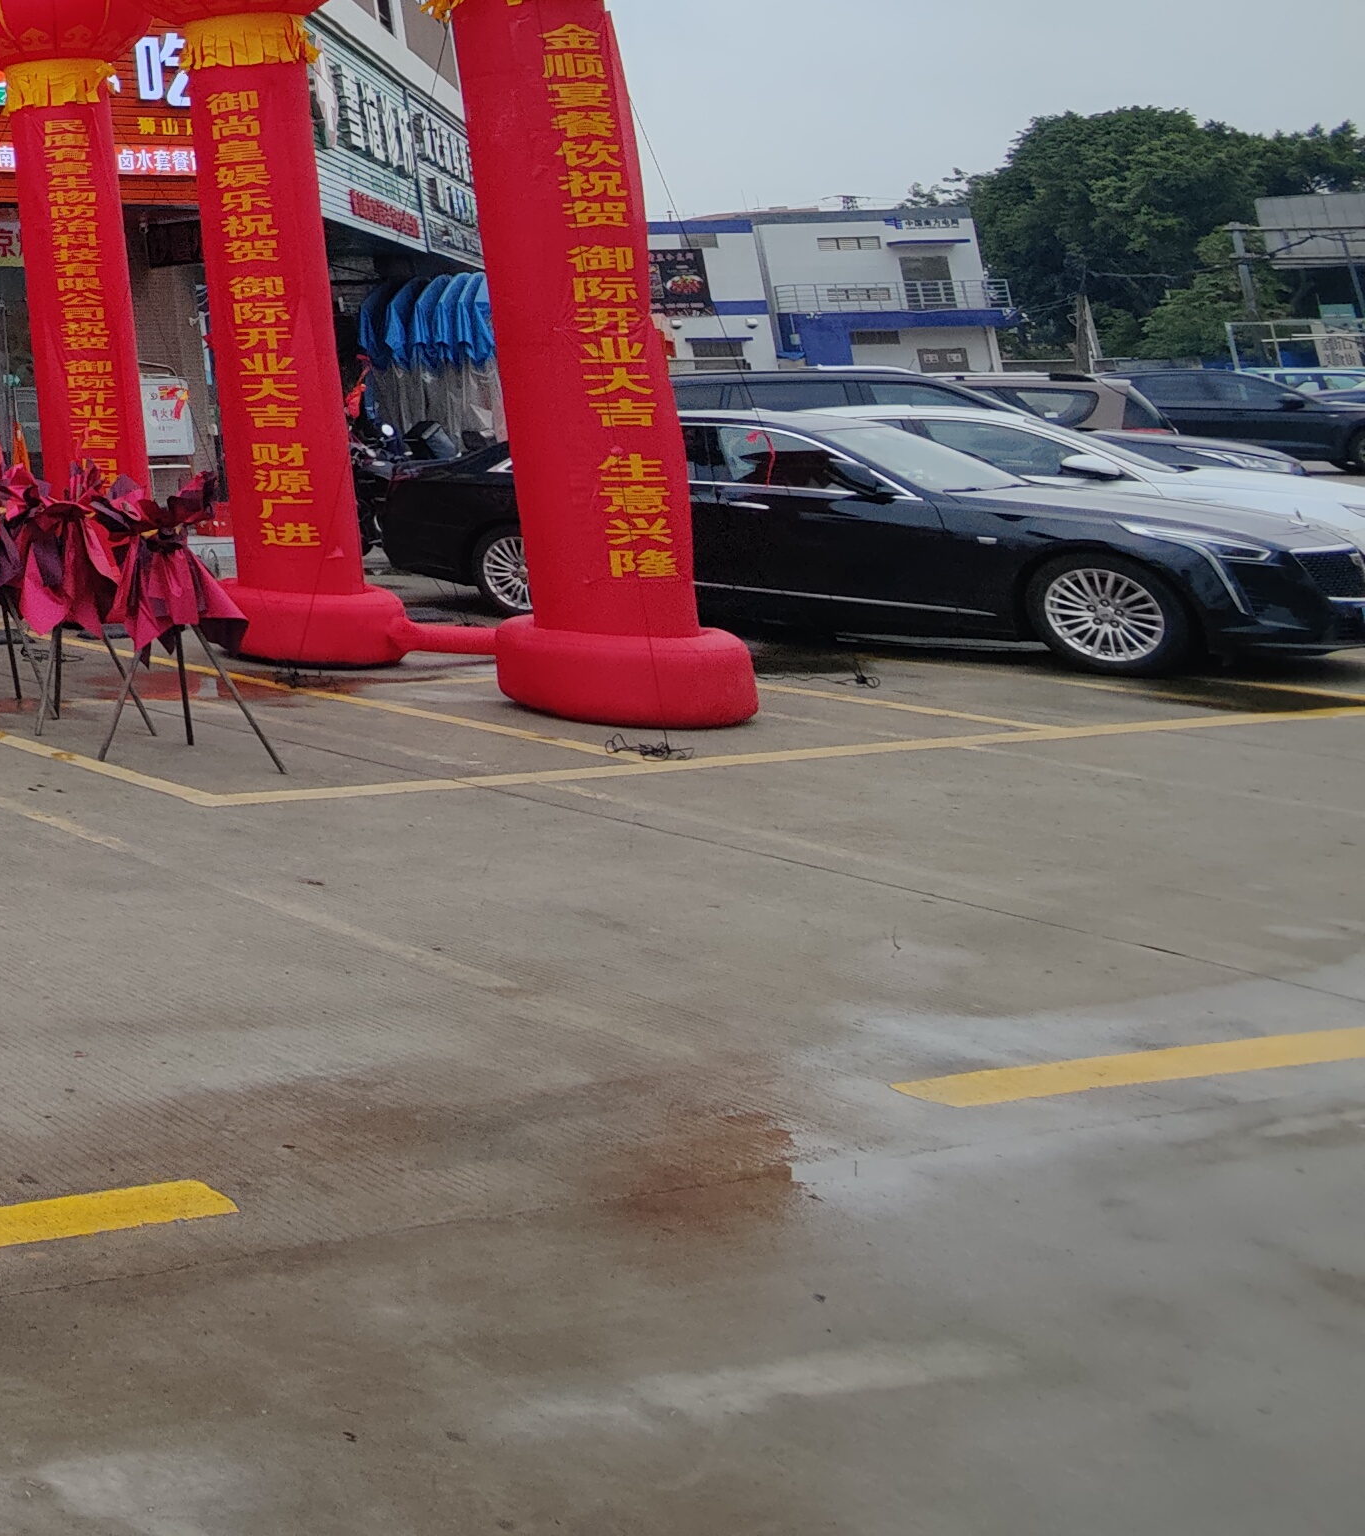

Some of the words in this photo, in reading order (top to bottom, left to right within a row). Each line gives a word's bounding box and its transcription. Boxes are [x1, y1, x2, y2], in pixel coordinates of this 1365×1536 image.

[117, 148, 198, 172] 卤水套餐
[204, 90, 280, 263] 御尚皇娱乐祝贺
[229, 275, 300, 430] 御际开业大吉
[566, 244, 659, 429] 御际开业大吉
[250, 441, 322, 549] 财源广进
[599, 451, 680, 579] 生意兴隆
